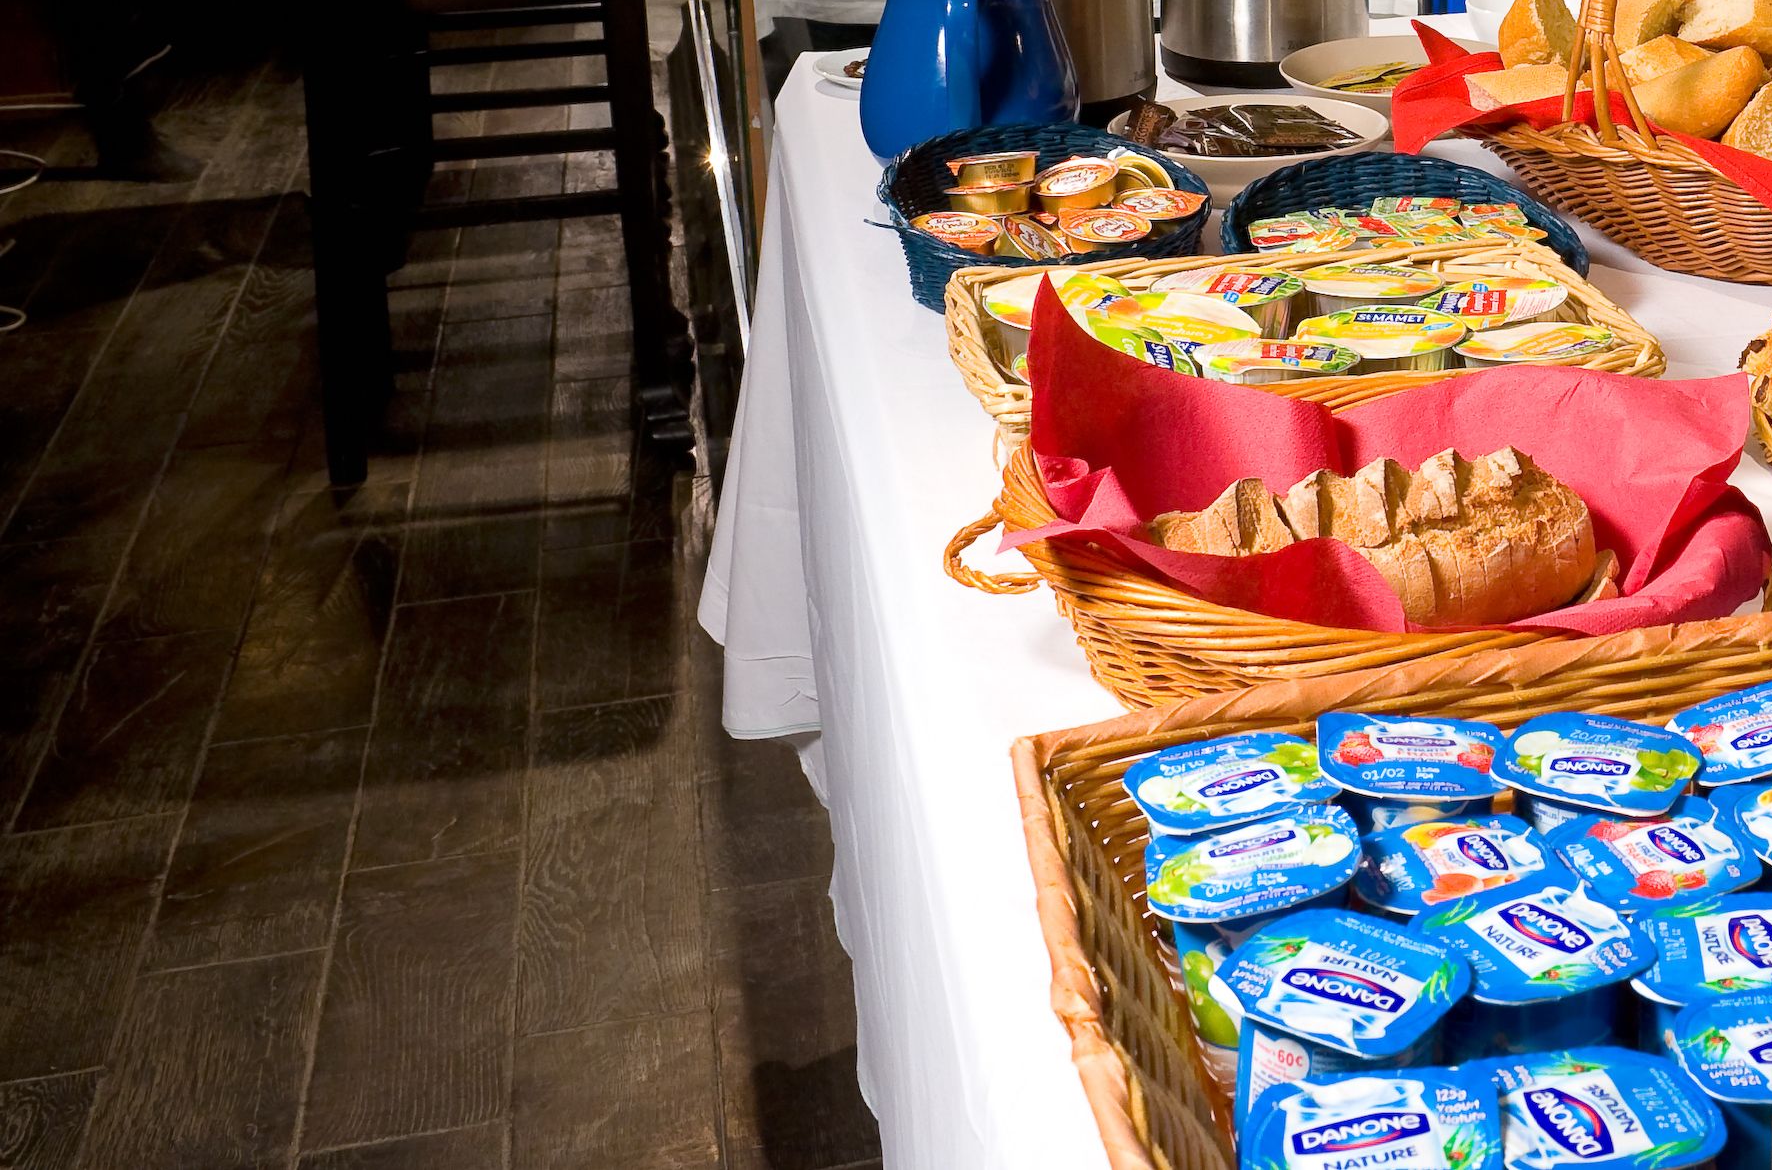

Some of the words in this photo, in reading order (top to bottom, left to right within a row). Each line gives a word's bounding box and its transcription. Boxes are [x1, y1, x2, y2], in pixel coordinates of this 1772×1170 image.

[1361, 767, 1406, 780] 01/02
[1481, 924, 1540, 961] NATURE
[1701, 925, 1735, 966] NATURE
[1320, 954, 1400, 983] NATURE
[1582, 1083, 1639, 1134] NATURE
[1323, 1145, 1419, 1170] NATURE
